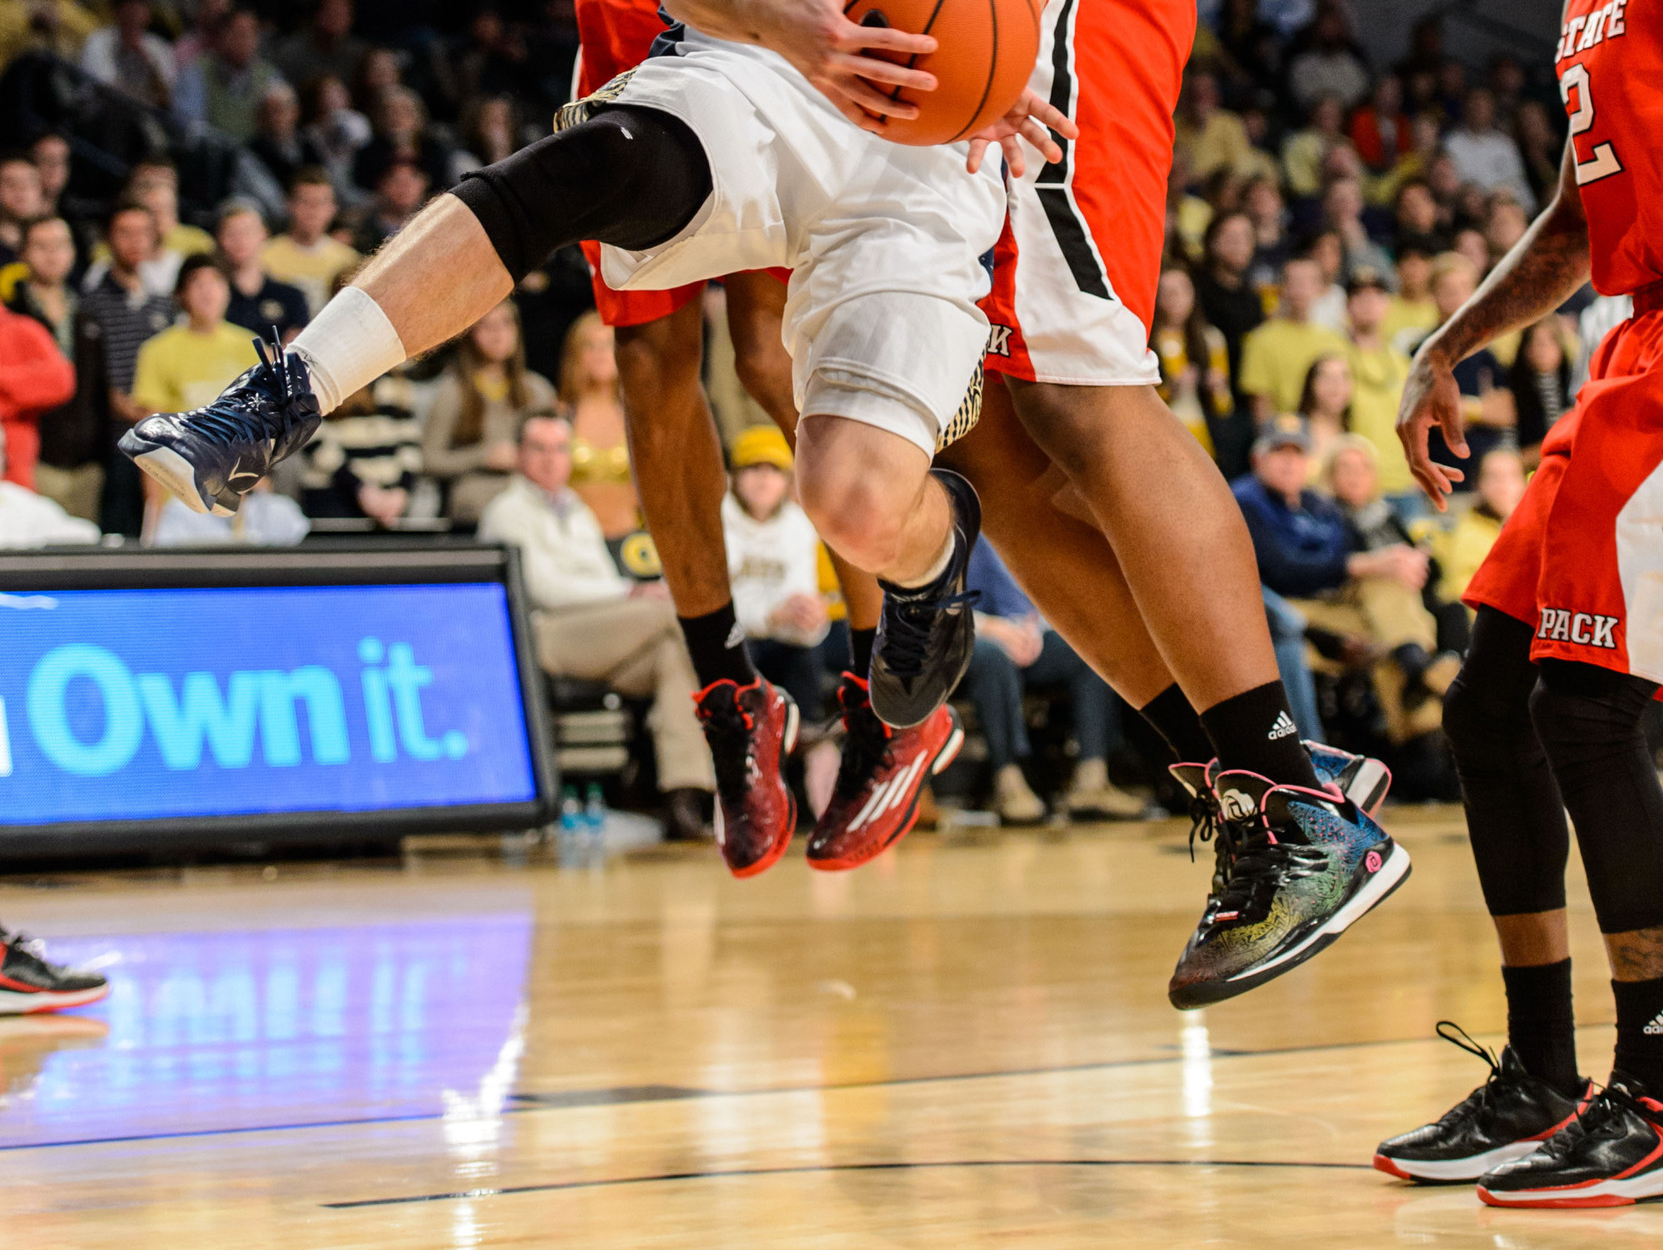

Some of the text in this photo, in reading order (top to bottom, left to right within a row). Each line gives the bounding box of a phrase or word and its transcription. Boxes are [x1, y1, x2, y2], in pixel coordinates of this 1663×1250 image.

[1537, 607, 1619, 649] PACK
[26, 642, 351, 777] Own
[357, 636, 469, 763] it.
